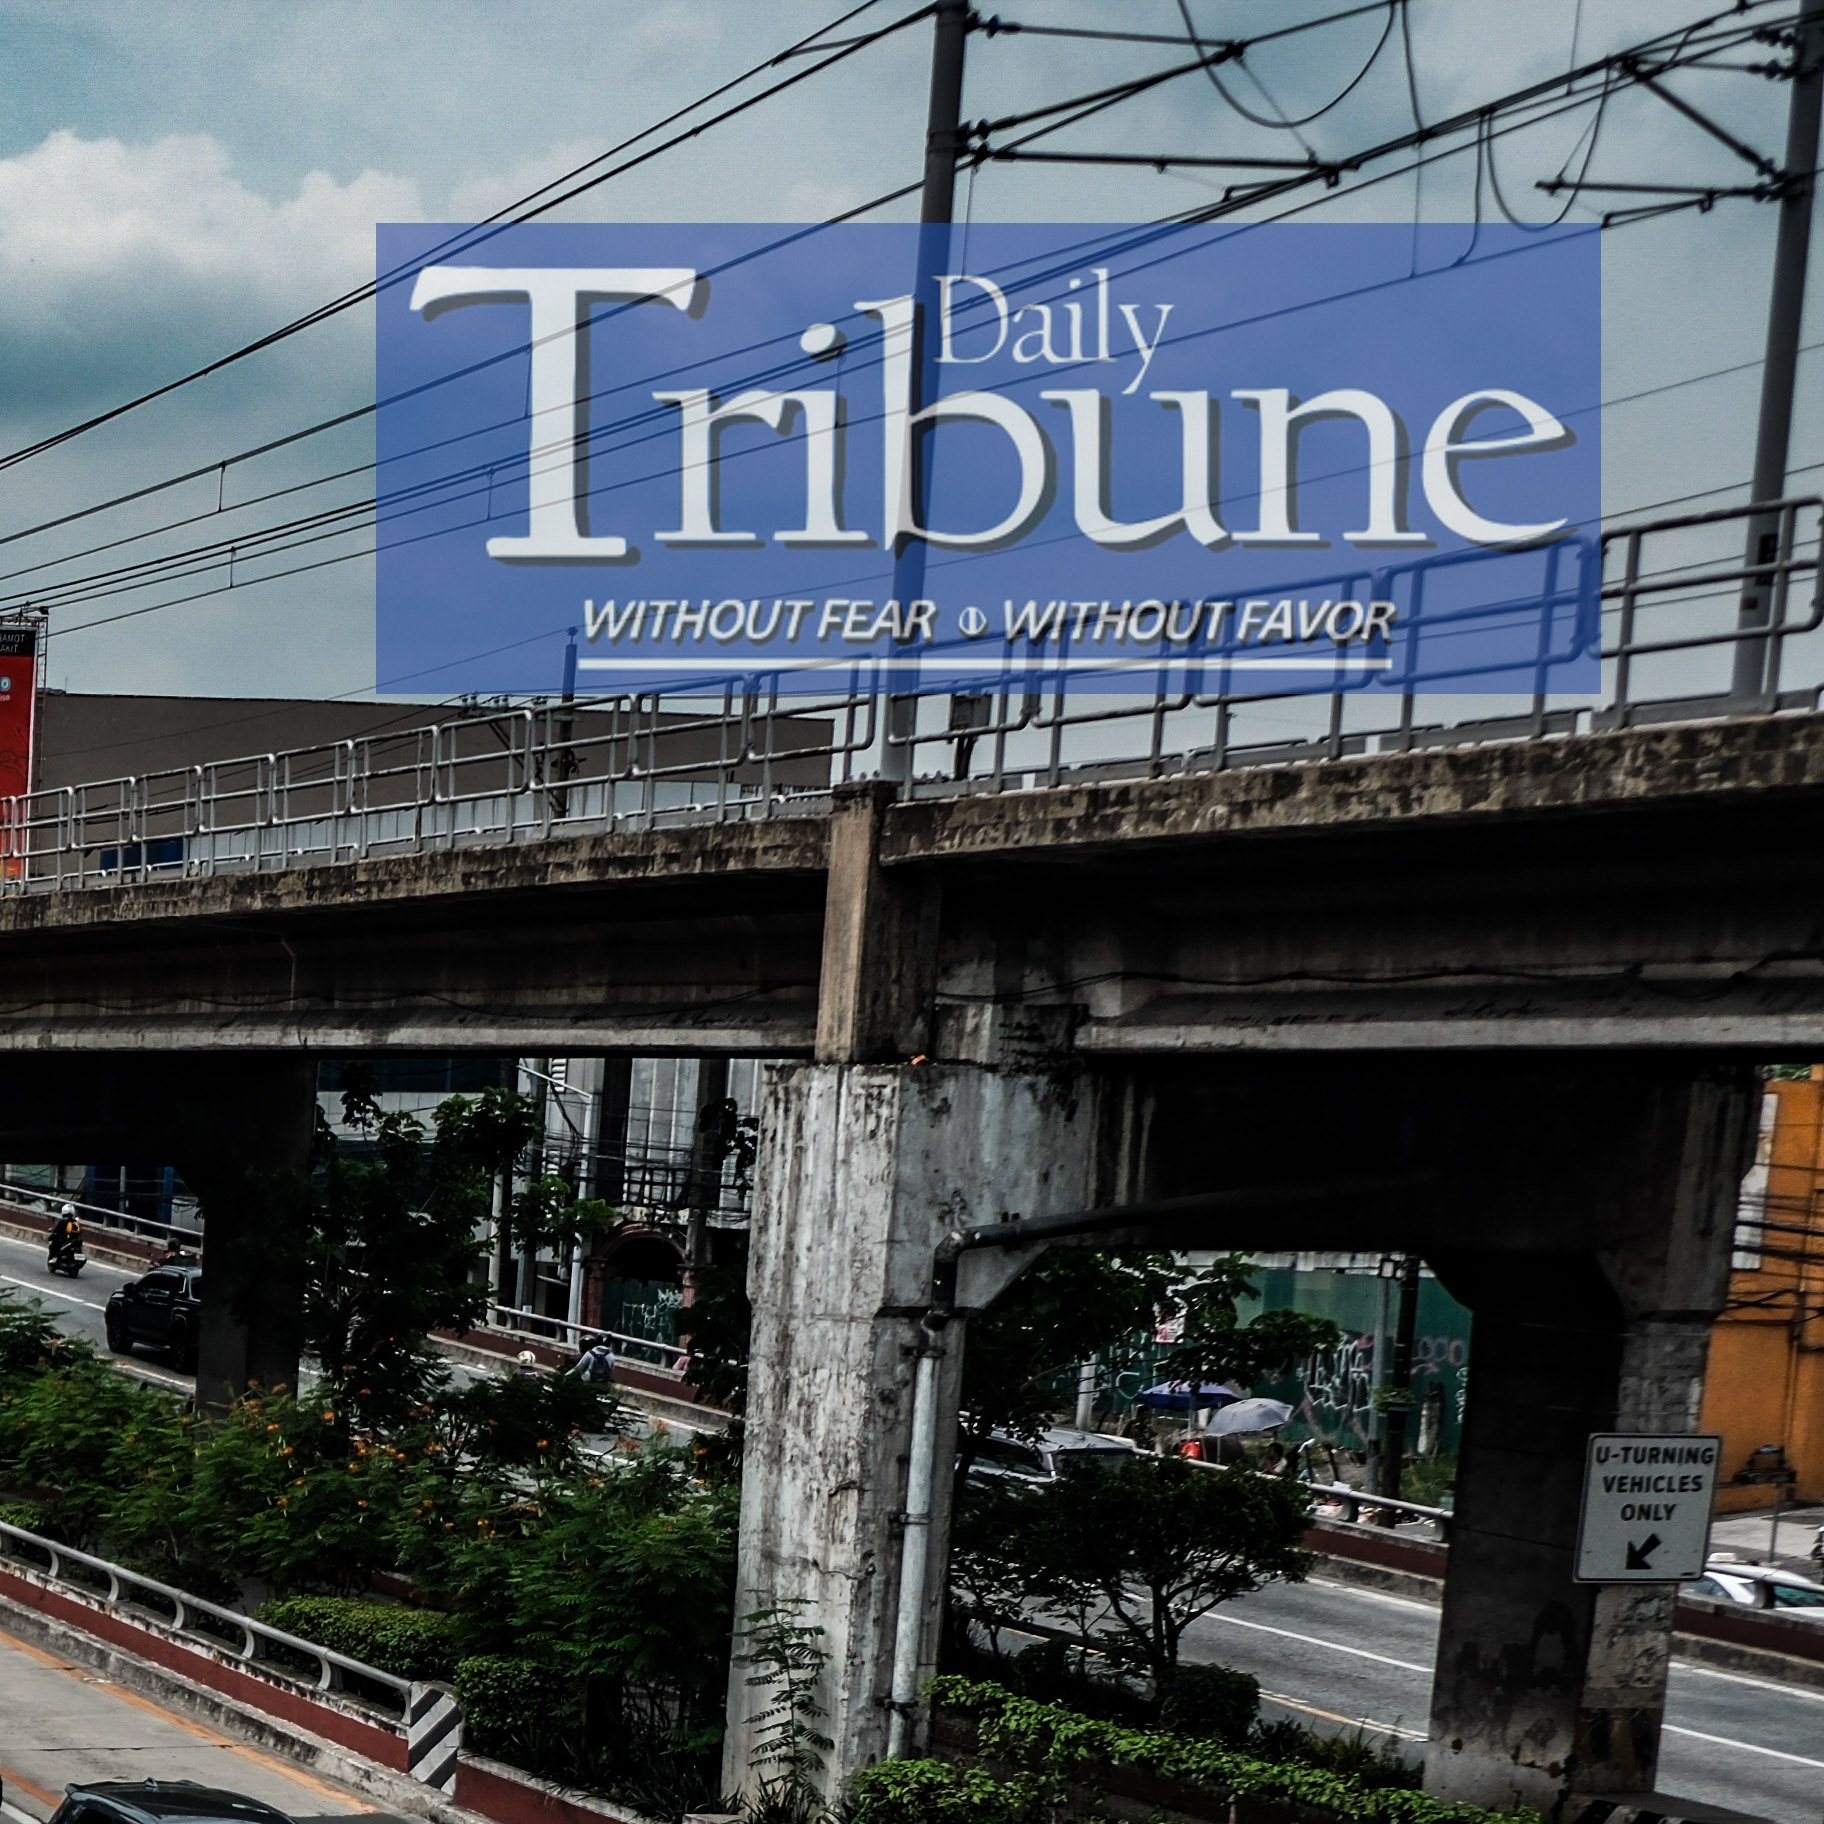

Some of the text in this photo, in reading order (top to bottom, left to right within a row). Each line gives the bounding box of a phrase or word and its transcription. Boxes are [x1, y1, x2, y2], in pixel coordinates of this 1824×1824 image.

[1595, 1445, 1715, 1466] U-TURNING
[1602, 1475, 1703, 1494] VEHICLES
[1620, 1503, 1676, 1522] ONLY
